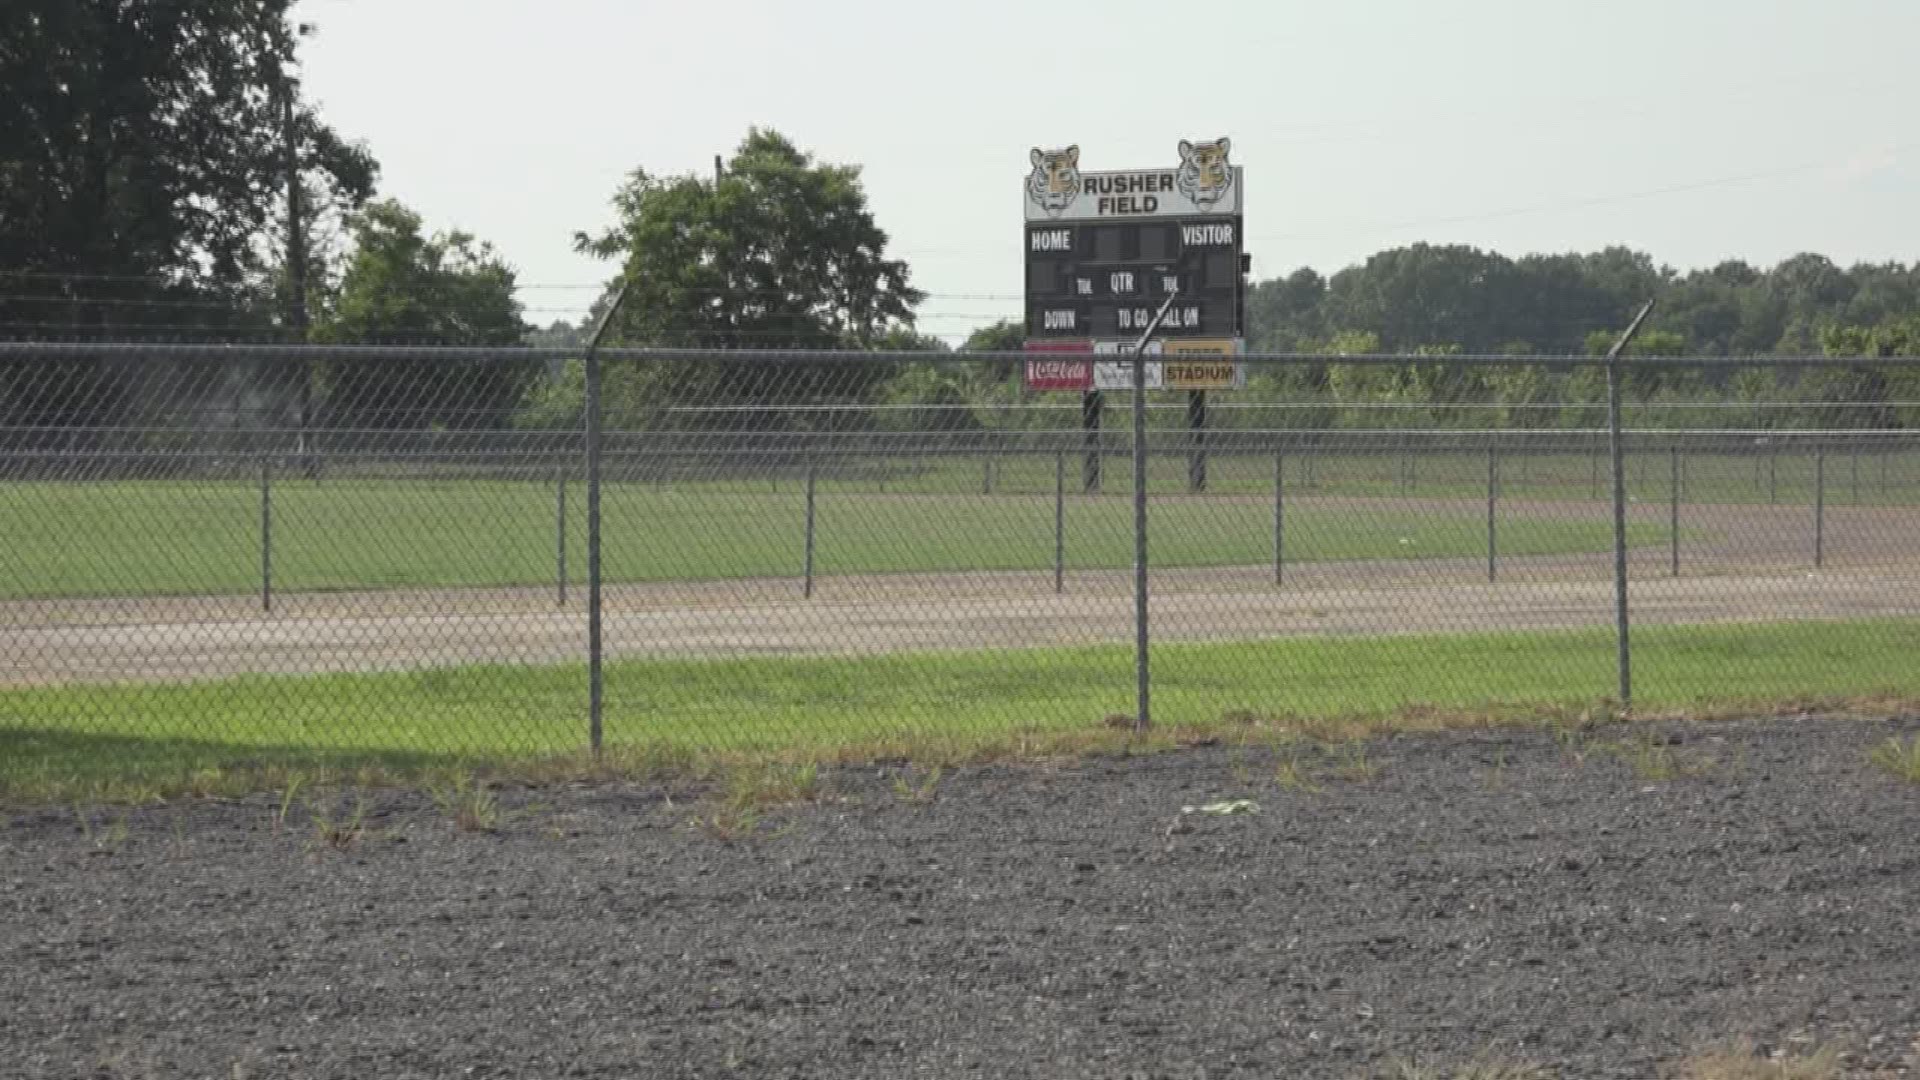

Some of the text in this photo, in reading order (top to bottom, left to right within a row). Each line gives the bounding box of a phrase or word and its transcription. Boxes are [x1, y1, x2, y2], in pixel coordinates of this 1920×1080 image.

[1083, 174, 1174, 195] RUSHER
[1097, 196, 1159, 216] FIELD
[1031, 230, 1071, 251] HOME
[1182, 223, 1234, 247] VISITOR
[1110, 271, 1134, 294] QTR
[1044, 308, 1076, 330] DOWN
[1118, 307, 1149, 329] TO GO
[1183, 305, 1199, 327] ON
[1166, 365, 1235, 381] STADIUM
